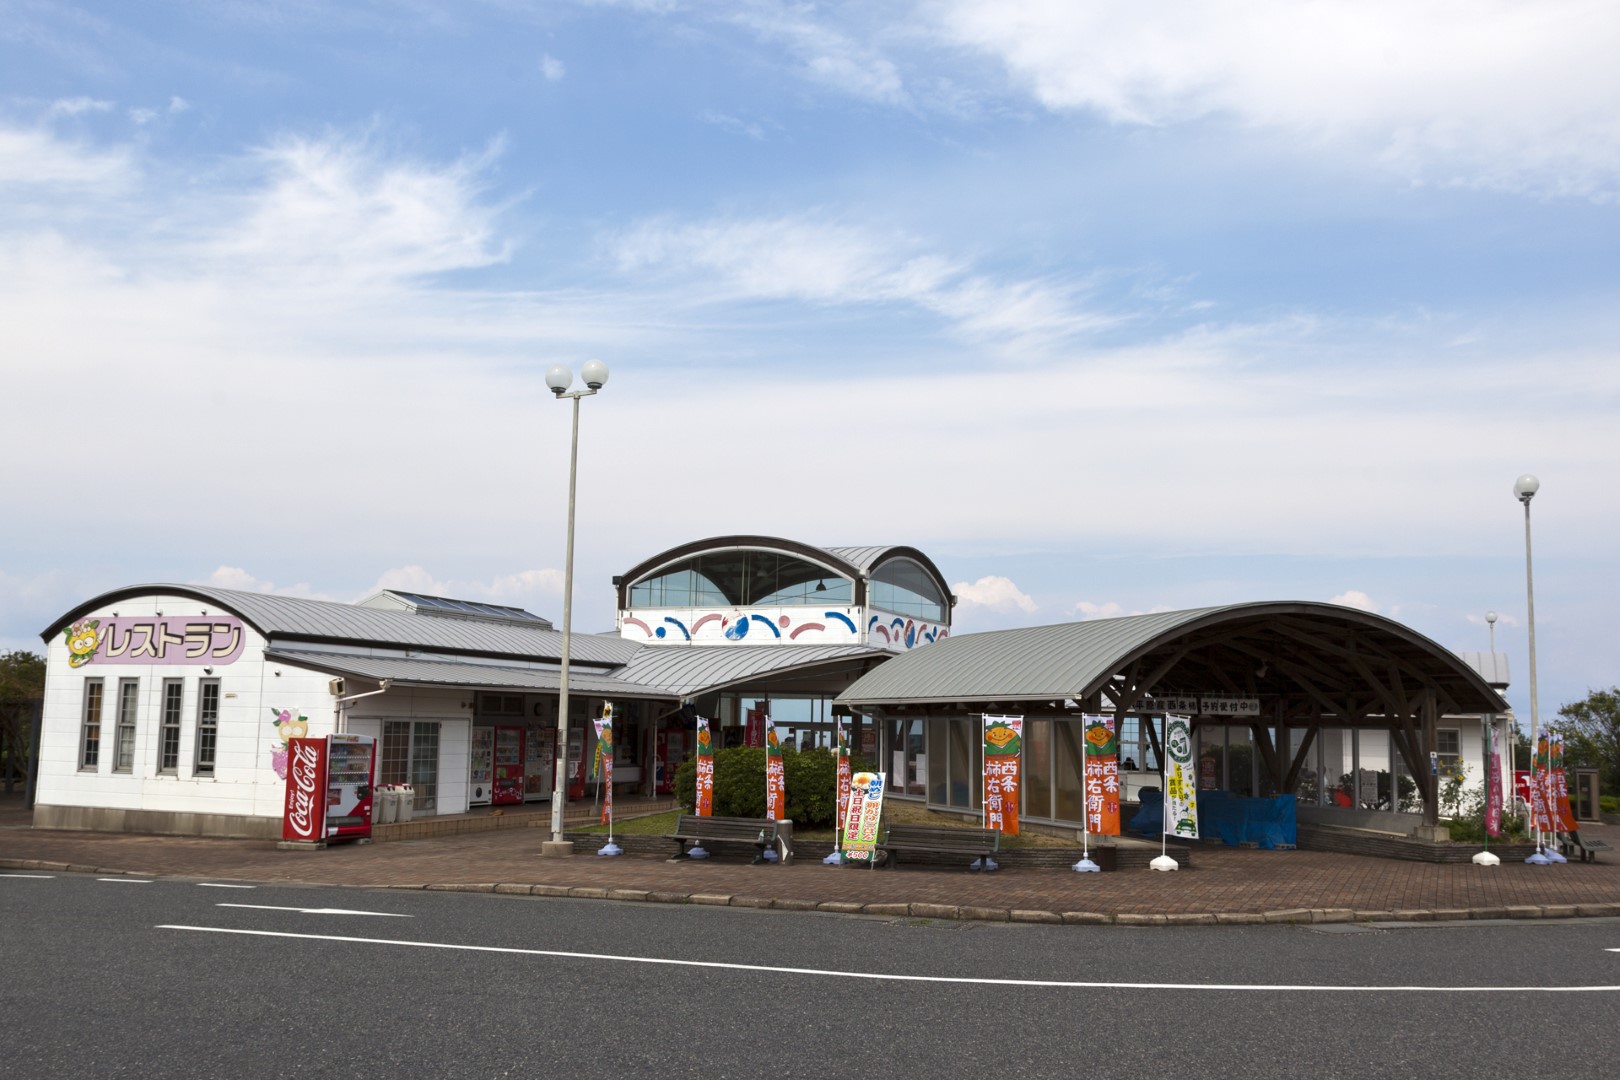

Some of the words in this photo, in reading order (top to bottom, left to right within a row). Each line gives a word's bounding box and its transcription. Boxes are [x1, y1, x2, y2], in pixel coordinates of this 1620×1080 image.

[106, 622, 241, 659] レストラン
[288, 740, 318, 836] Coca-Cola
[869, 780, 882, 800] 朝めし
[1001, 760, 1018, 793] 西条
[1103, 760, 1119, 793] 西条
[846, 787, 864, 841] 土日祝日限定
[846, 850, 869, 860] ¥500
